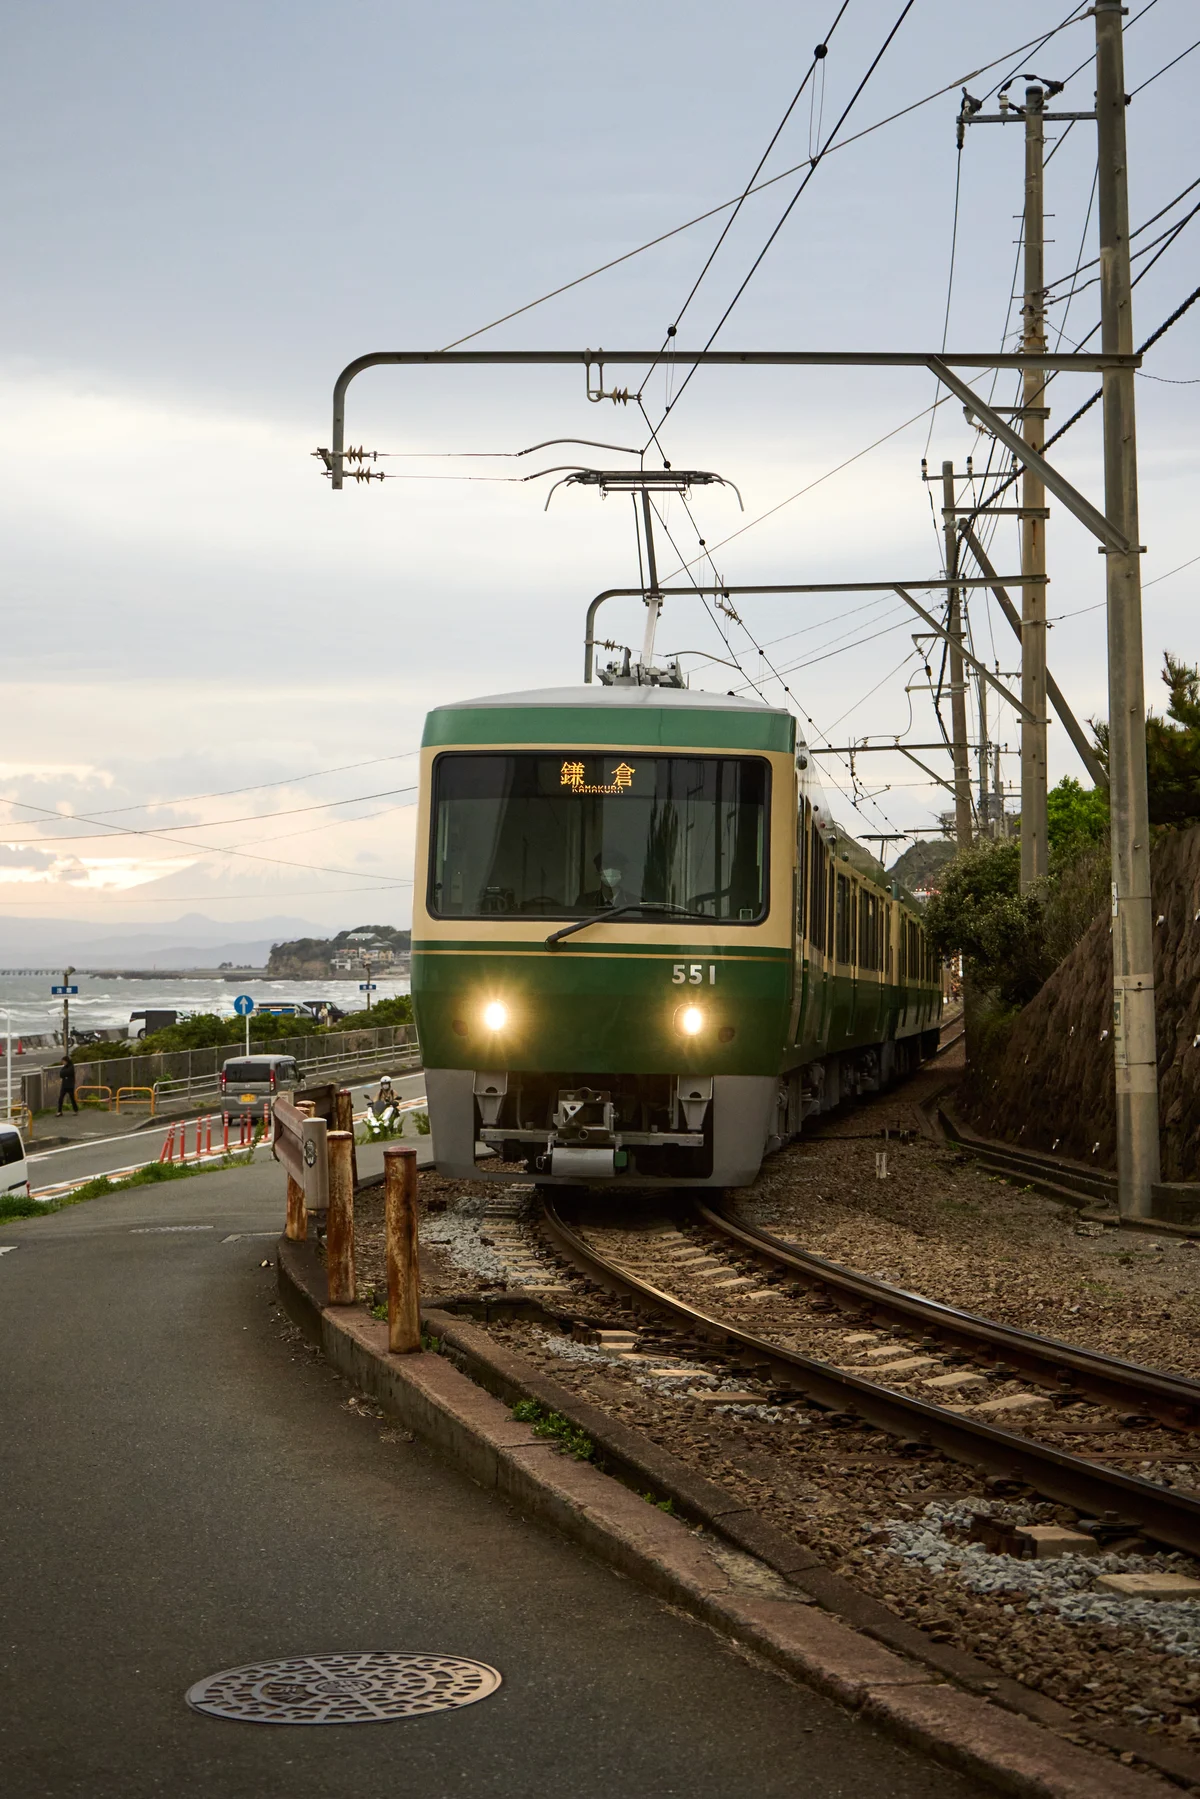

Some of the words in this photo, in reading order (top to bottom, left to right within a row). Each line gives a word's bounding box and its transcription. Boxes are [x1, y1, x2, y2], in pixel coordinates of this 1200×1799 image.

[560, 761, 636, 787] 鎌倉
[571, 784, 624, 794] KAMAKURA
[671, 964, 716, 985] 551
